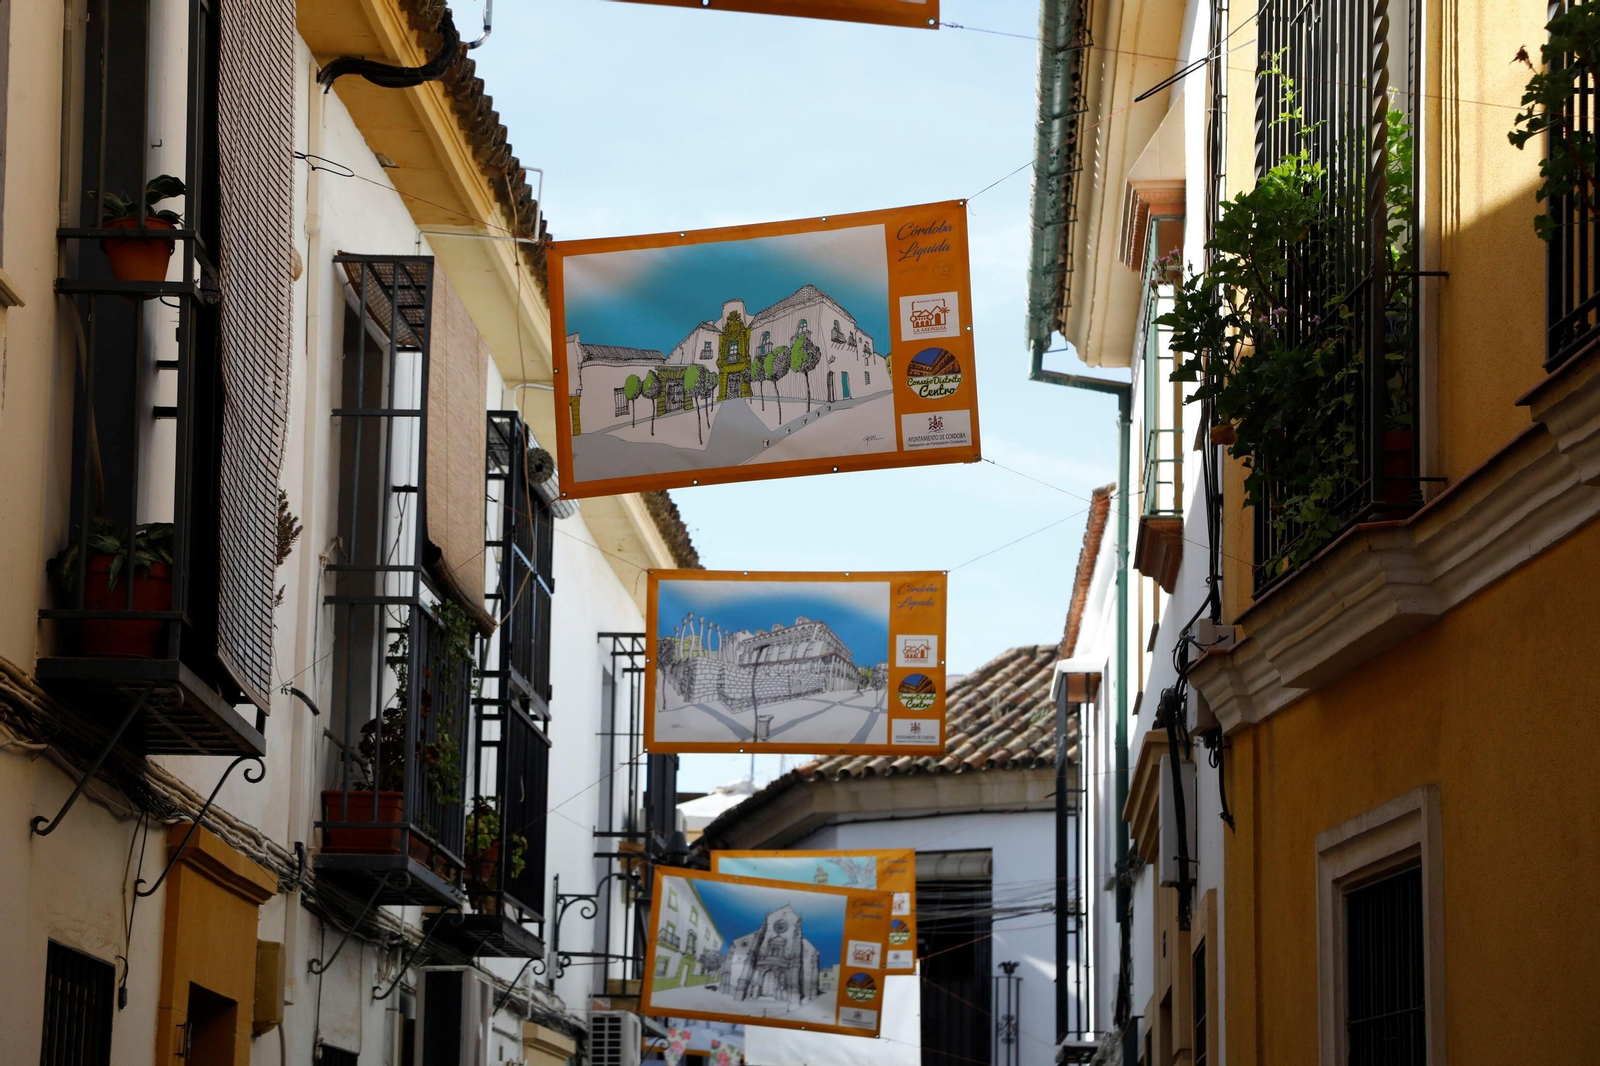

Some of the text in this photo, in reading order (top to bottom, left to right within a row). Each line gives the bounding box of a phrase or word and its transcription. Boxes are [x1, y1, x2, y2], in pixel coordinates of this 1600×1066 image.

[896, 220, 954, 241] Córdoba
[935, 264, 951, 276] 19
[907, 375, 963, 387] Consejo Distrito
[919, 384, 956, 398] Centro
[908, 434, 939, 443] AYUNTAMIENTO
[905, 699, 932, 709] Centro
